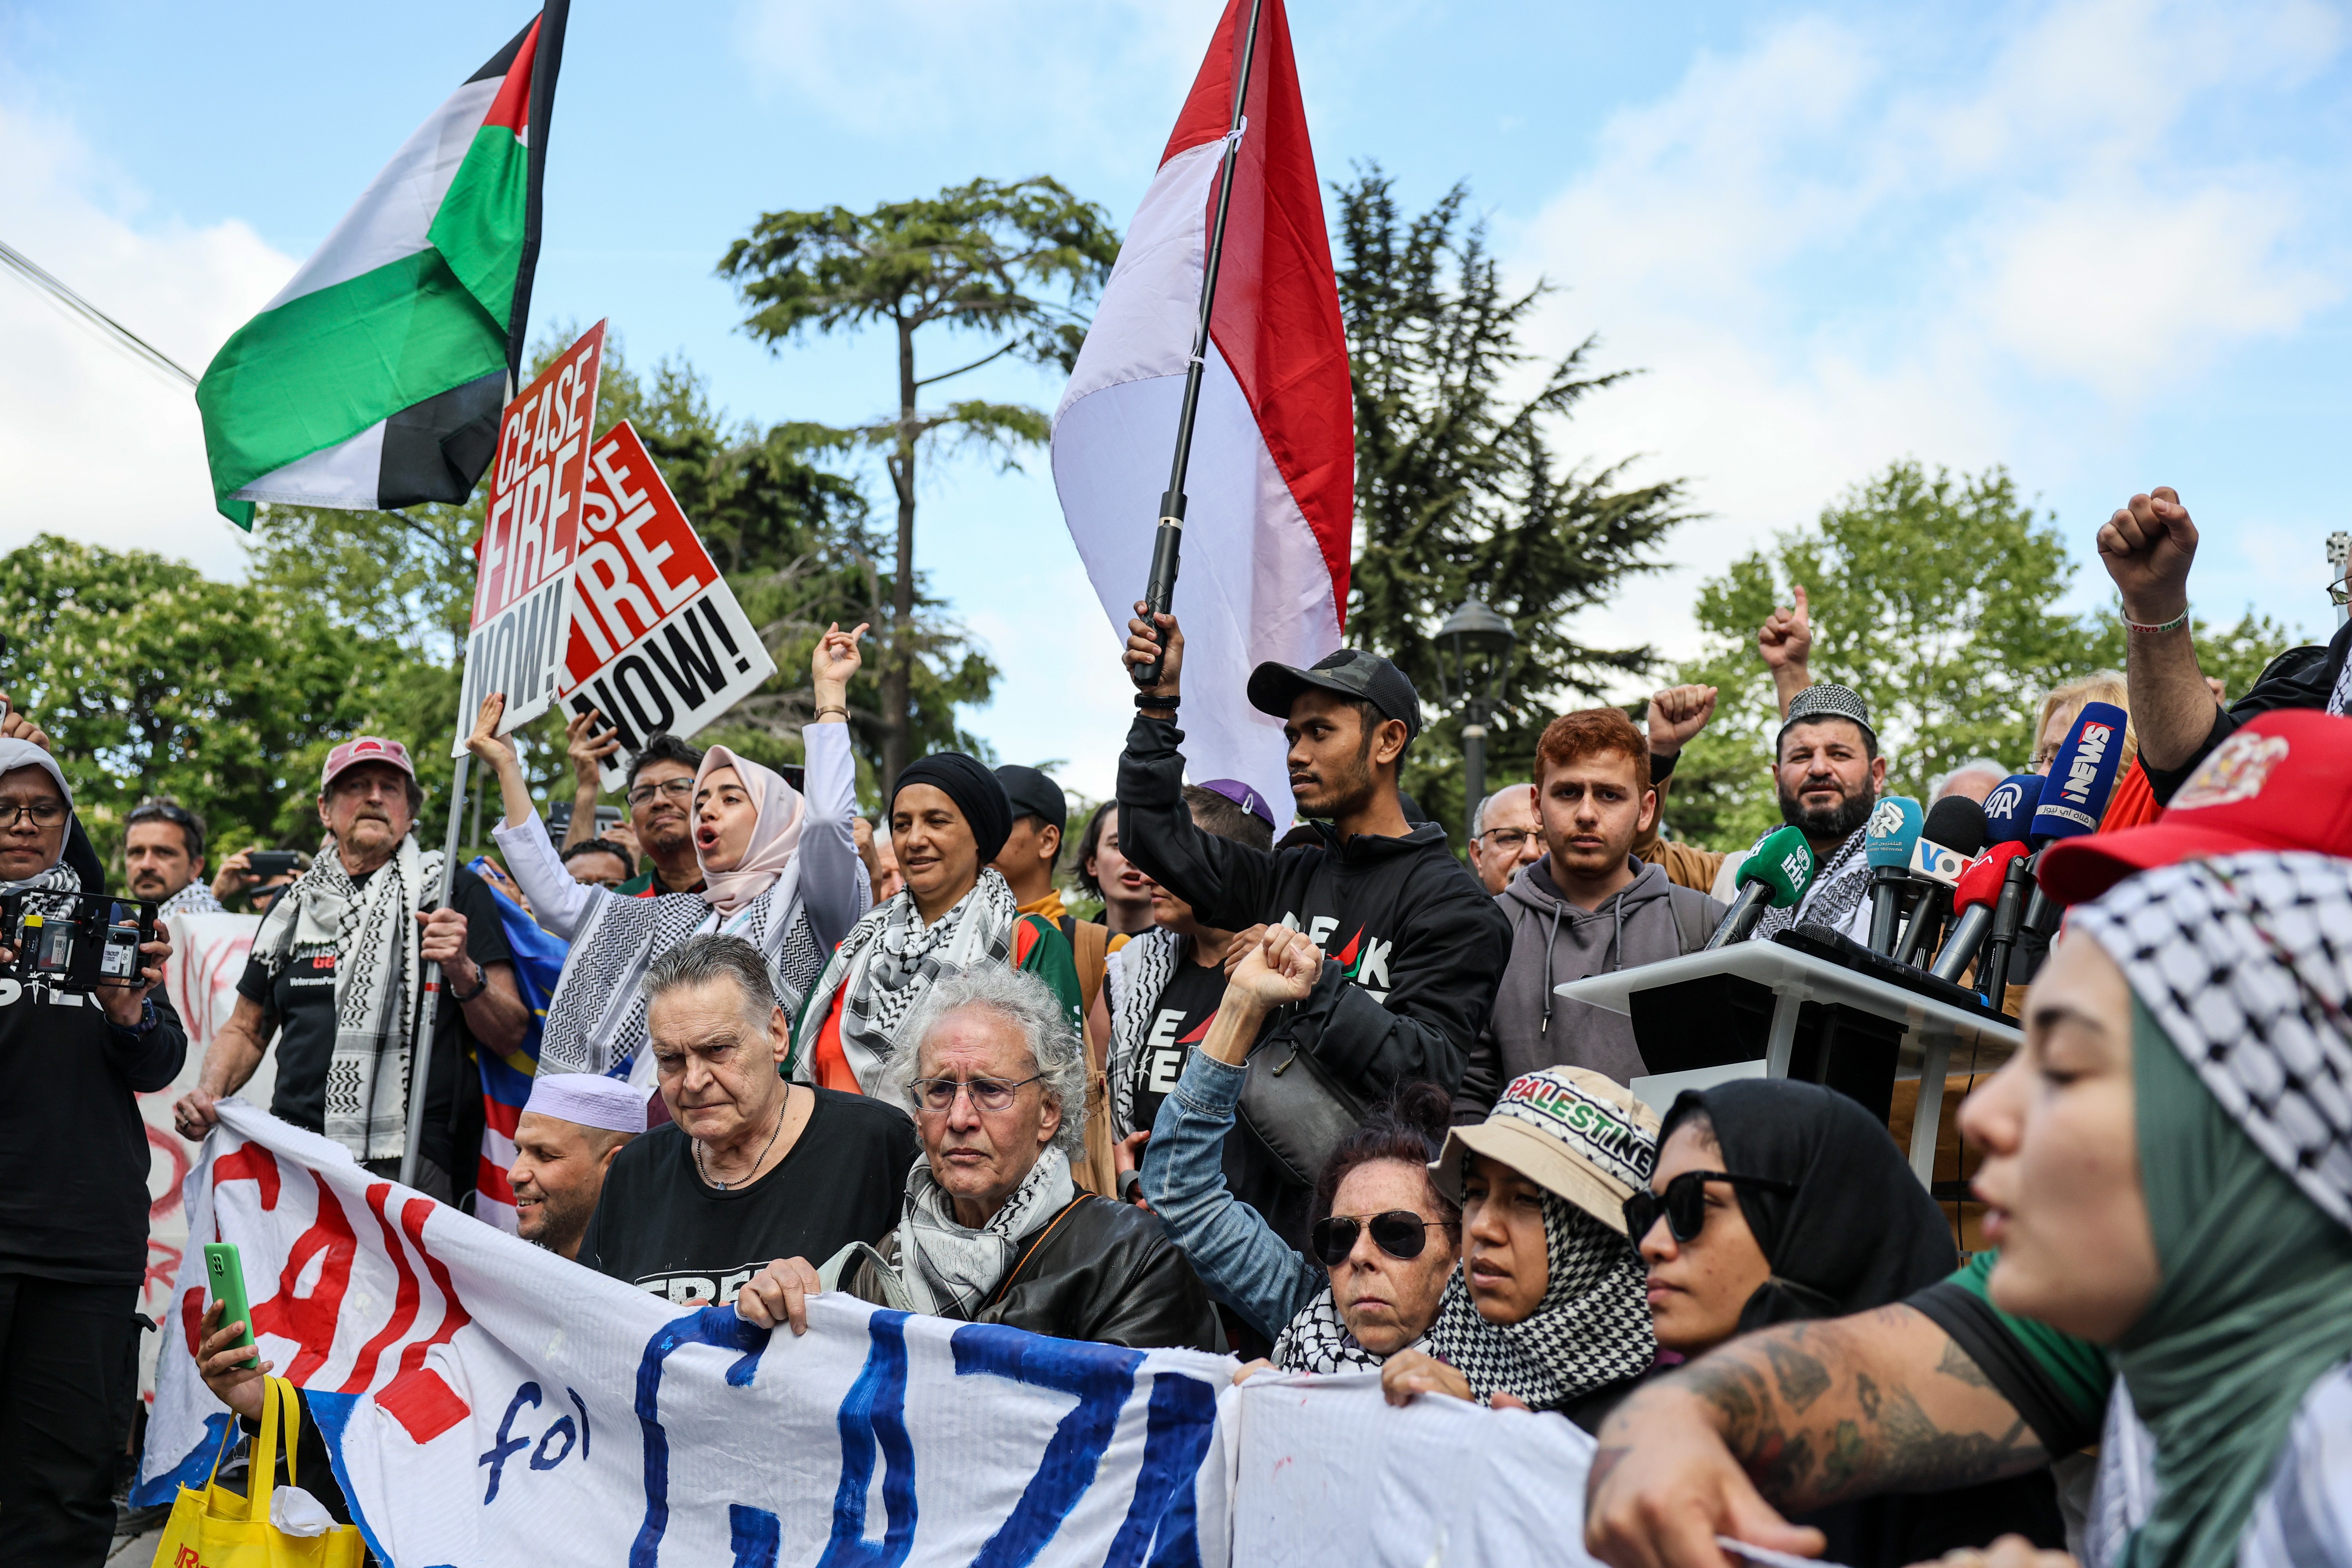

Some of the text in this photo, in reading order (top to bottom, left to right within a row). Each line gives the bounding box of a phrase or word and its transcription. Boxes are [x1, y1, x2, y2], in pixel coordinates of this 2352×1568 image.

[497, 344, 593, 497] CEASE
[477, 434, 580, 624] FIRE
[464, 577, 564, 740] NOW!
[570, 595, 751, 771] NOW!
[2132, 619, 2181, 633] SAVE GAZA
[2073, 812, 2089, 824] قناة
[1506, 1078, 1653, 1175] PALESTINE
